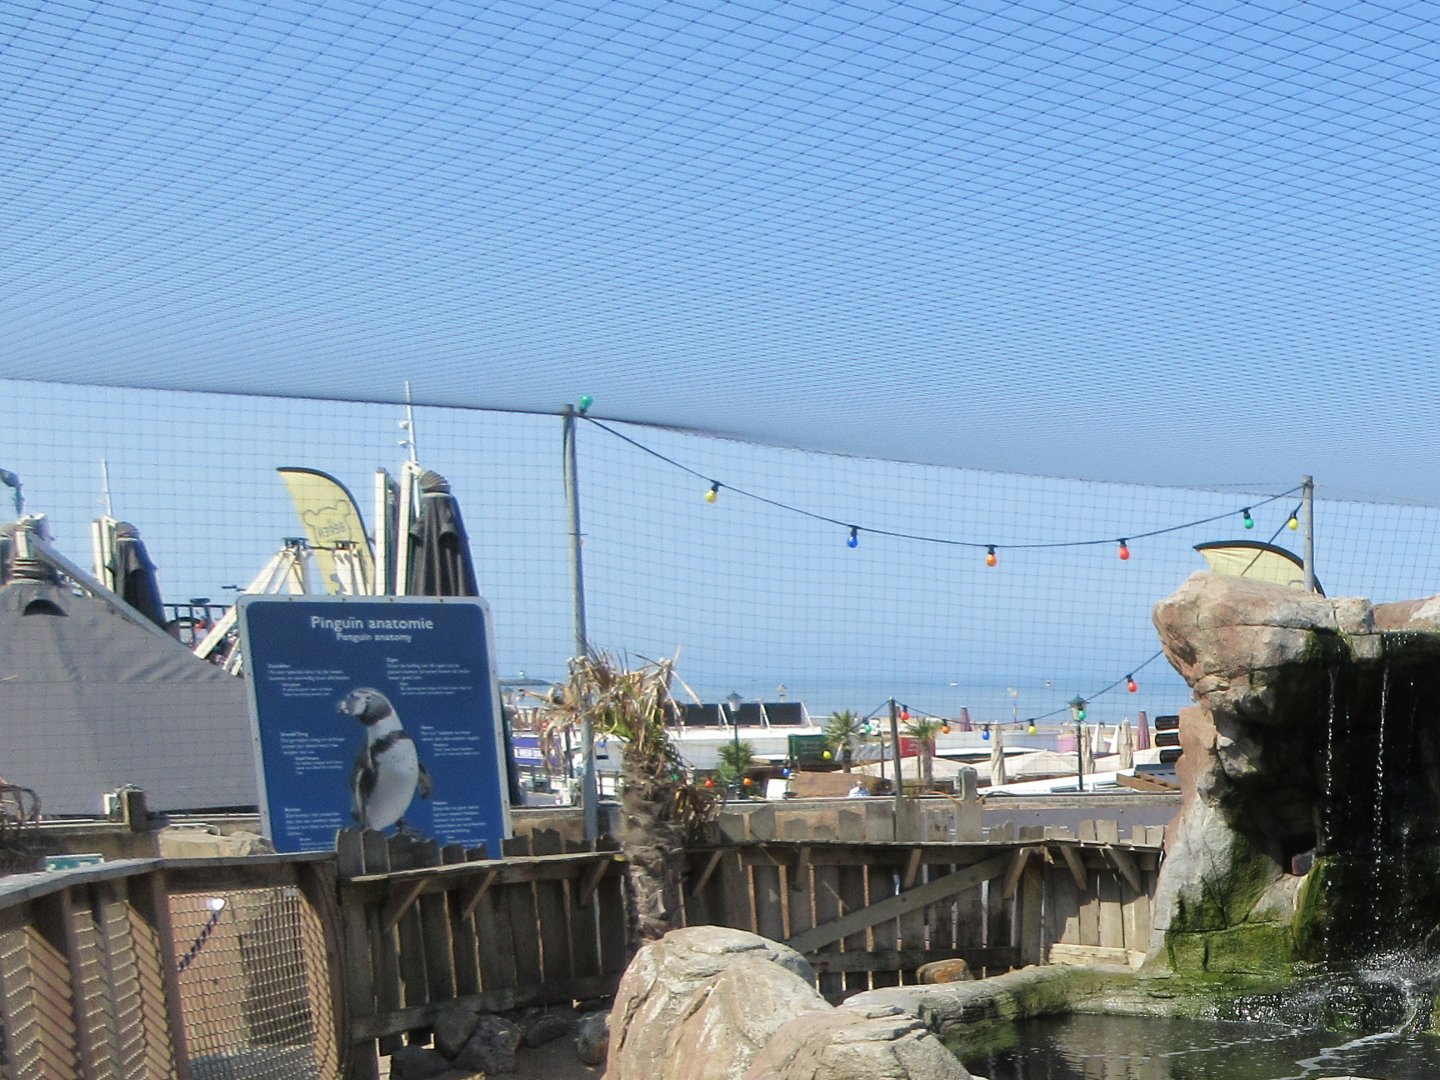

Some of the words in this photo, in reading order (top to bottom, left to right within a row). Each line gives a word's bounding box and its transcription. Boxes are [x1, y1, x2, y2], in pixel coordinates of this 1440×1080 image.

[310, 615, 364, 632] Pinguïn
[368, 617, 434, 629] anatomie
[336, 633, 372, 643] Penguin
[374, 634, 412, 643] anatomy
